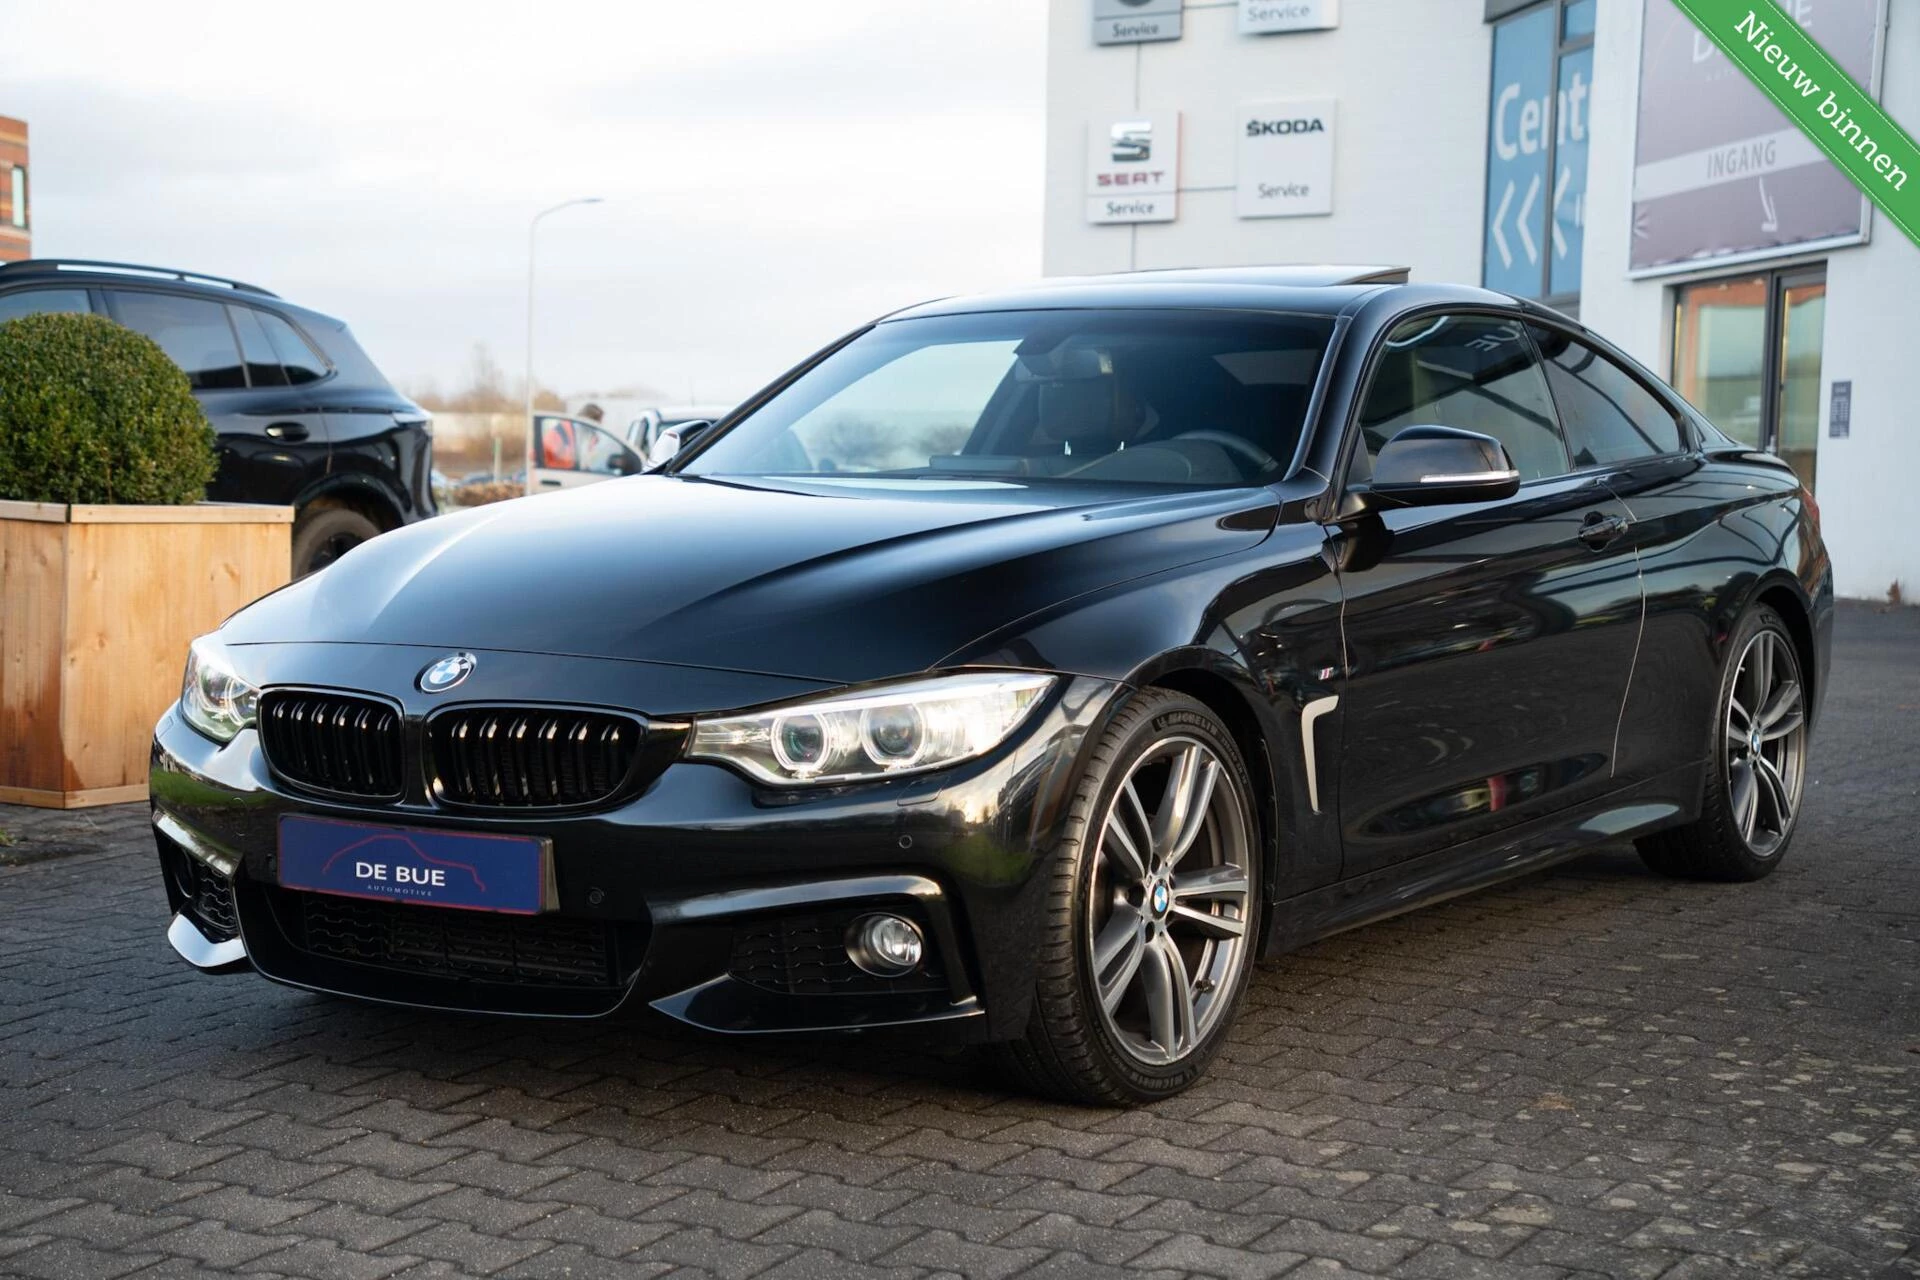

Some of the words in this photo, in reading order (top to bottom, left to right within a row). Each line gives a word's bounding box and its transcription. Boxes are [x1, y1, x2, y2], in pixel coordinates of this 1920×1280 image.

[1248, 5, 1310, 22] Service
[1112, 21, 1160, 38] Service
[1494, 71, 1592, 161] Cent
[1706, 139, 1777, 180] INGANG
[1097, 171, 1165, 187] SEAT
[1258, 183, 1310, 199] Service
[1106, 202, 1155, 216] Service
[356, 862, 387, 881] DE
[396, 866, 445, 886] BUE
[367, 885, 432, 897] AUTOMOTIVE
